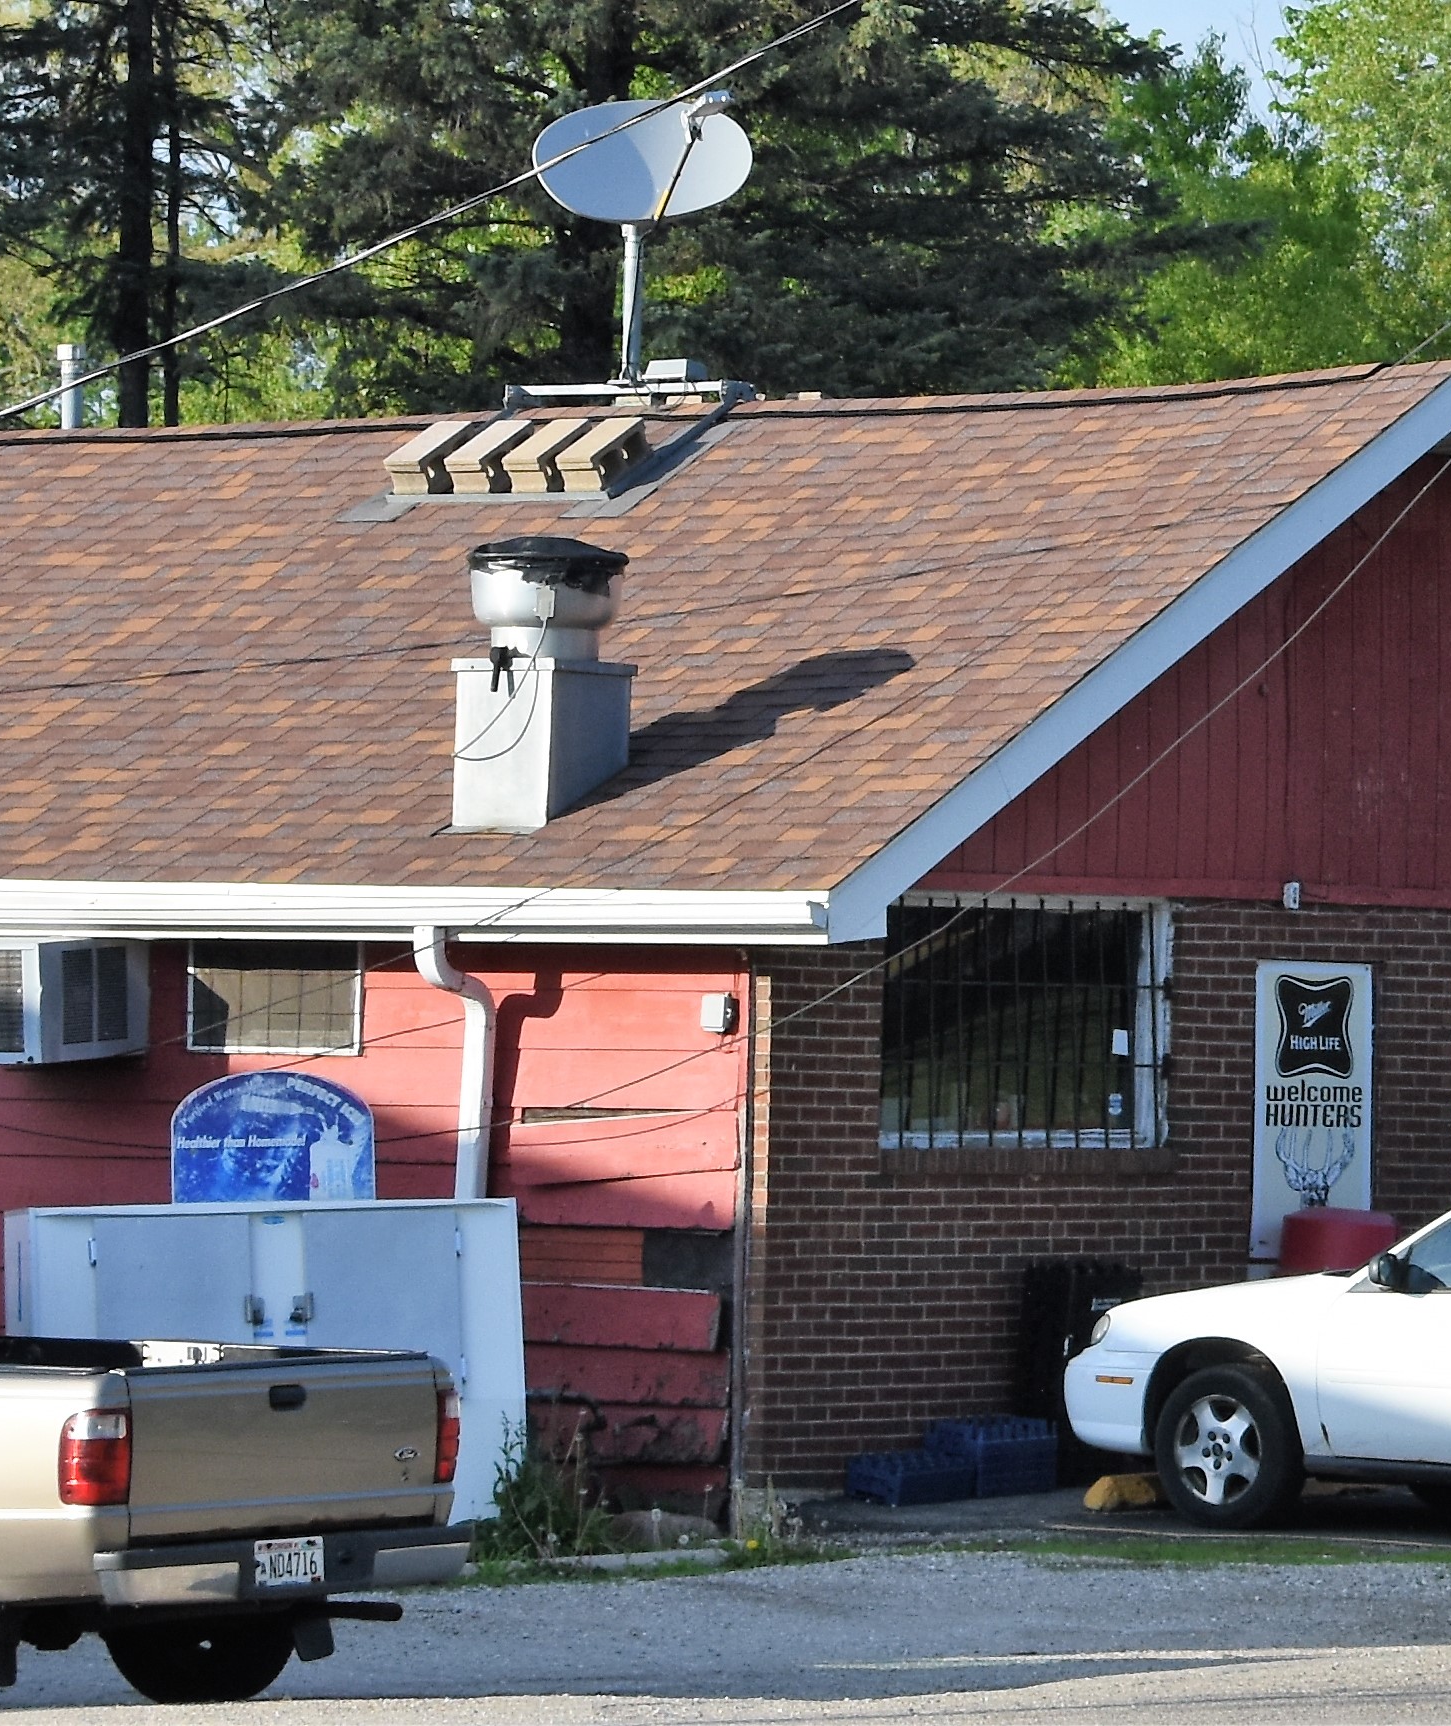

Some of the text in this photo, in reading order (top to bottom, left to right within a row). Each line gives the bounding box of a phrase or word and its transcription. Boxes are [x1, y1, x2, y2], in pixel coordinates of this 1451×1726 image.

[1290, 1034, 1341, 1051] HIGH LIFE
[1266, 1079, 1363, 1102] welcome
[1265, 1104, 1362, 1128] HUNTERS
